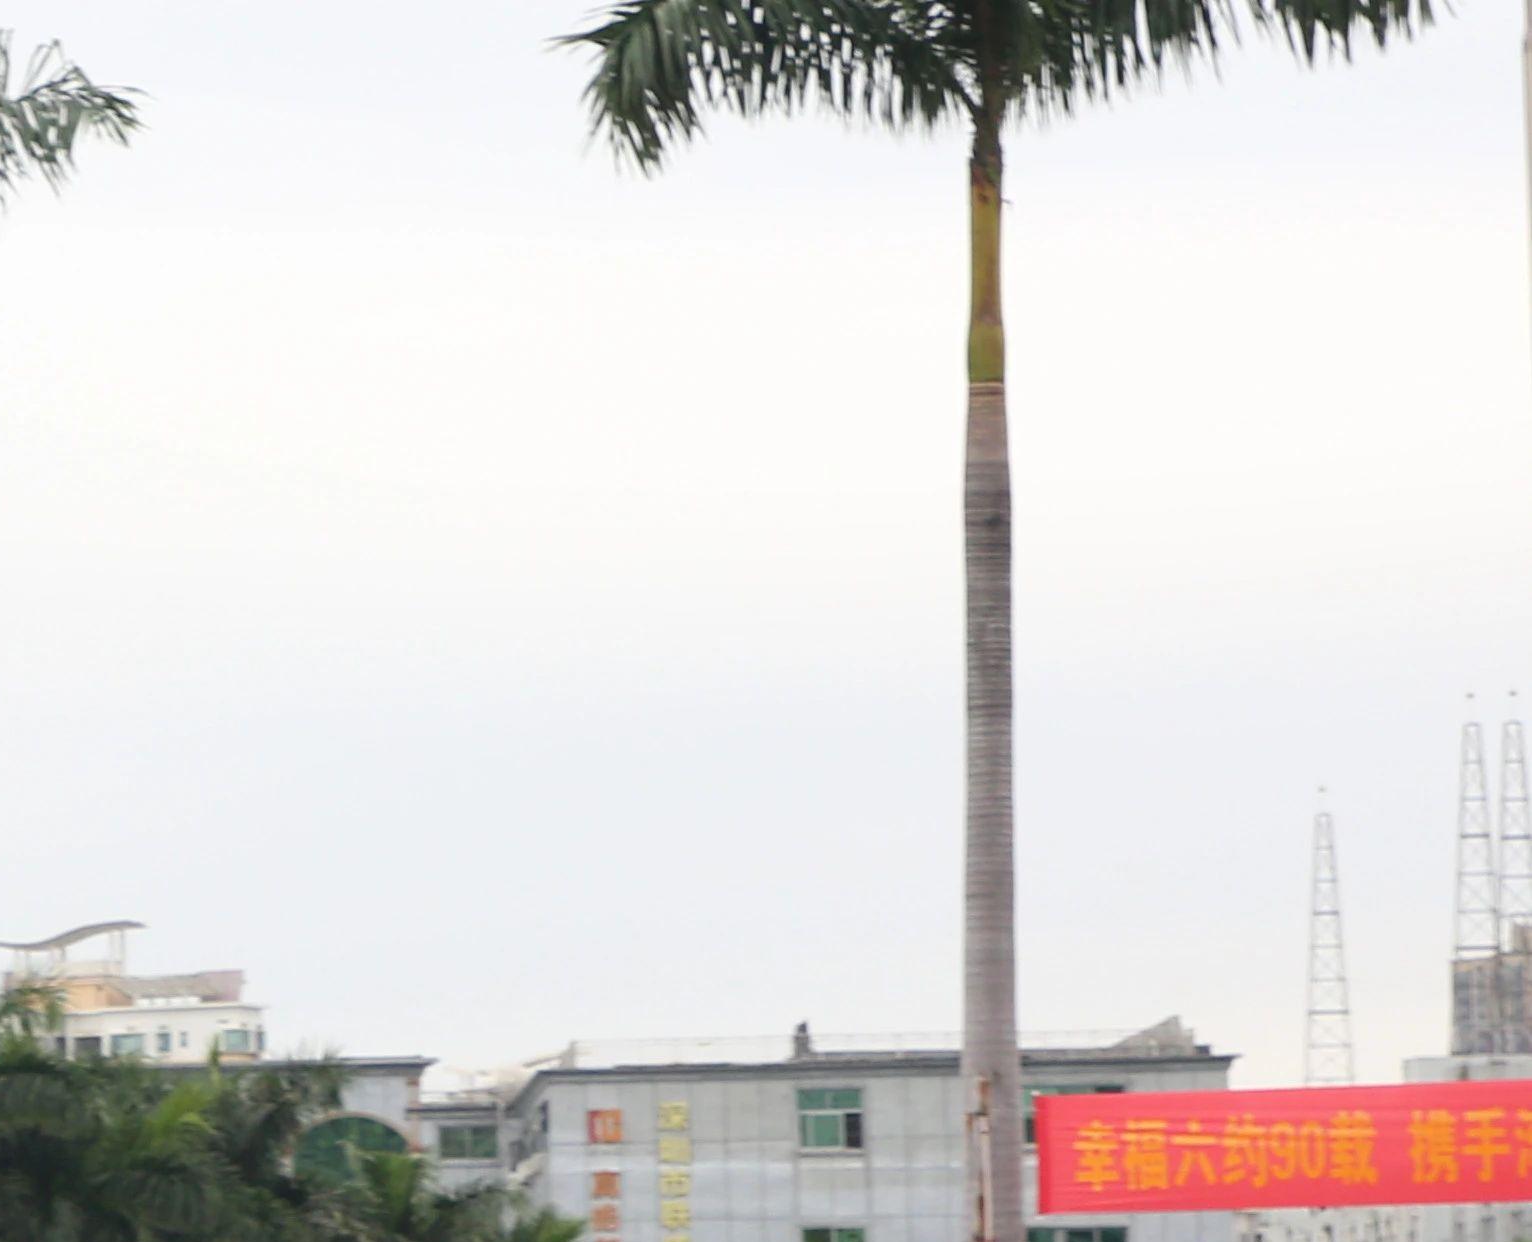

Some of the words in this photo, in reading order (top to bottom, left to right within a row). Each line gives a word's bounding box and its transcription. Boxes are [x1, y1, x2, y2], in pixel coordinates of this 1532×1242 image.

[1072, 1111, 1379, 1192] 幸福六约90载
